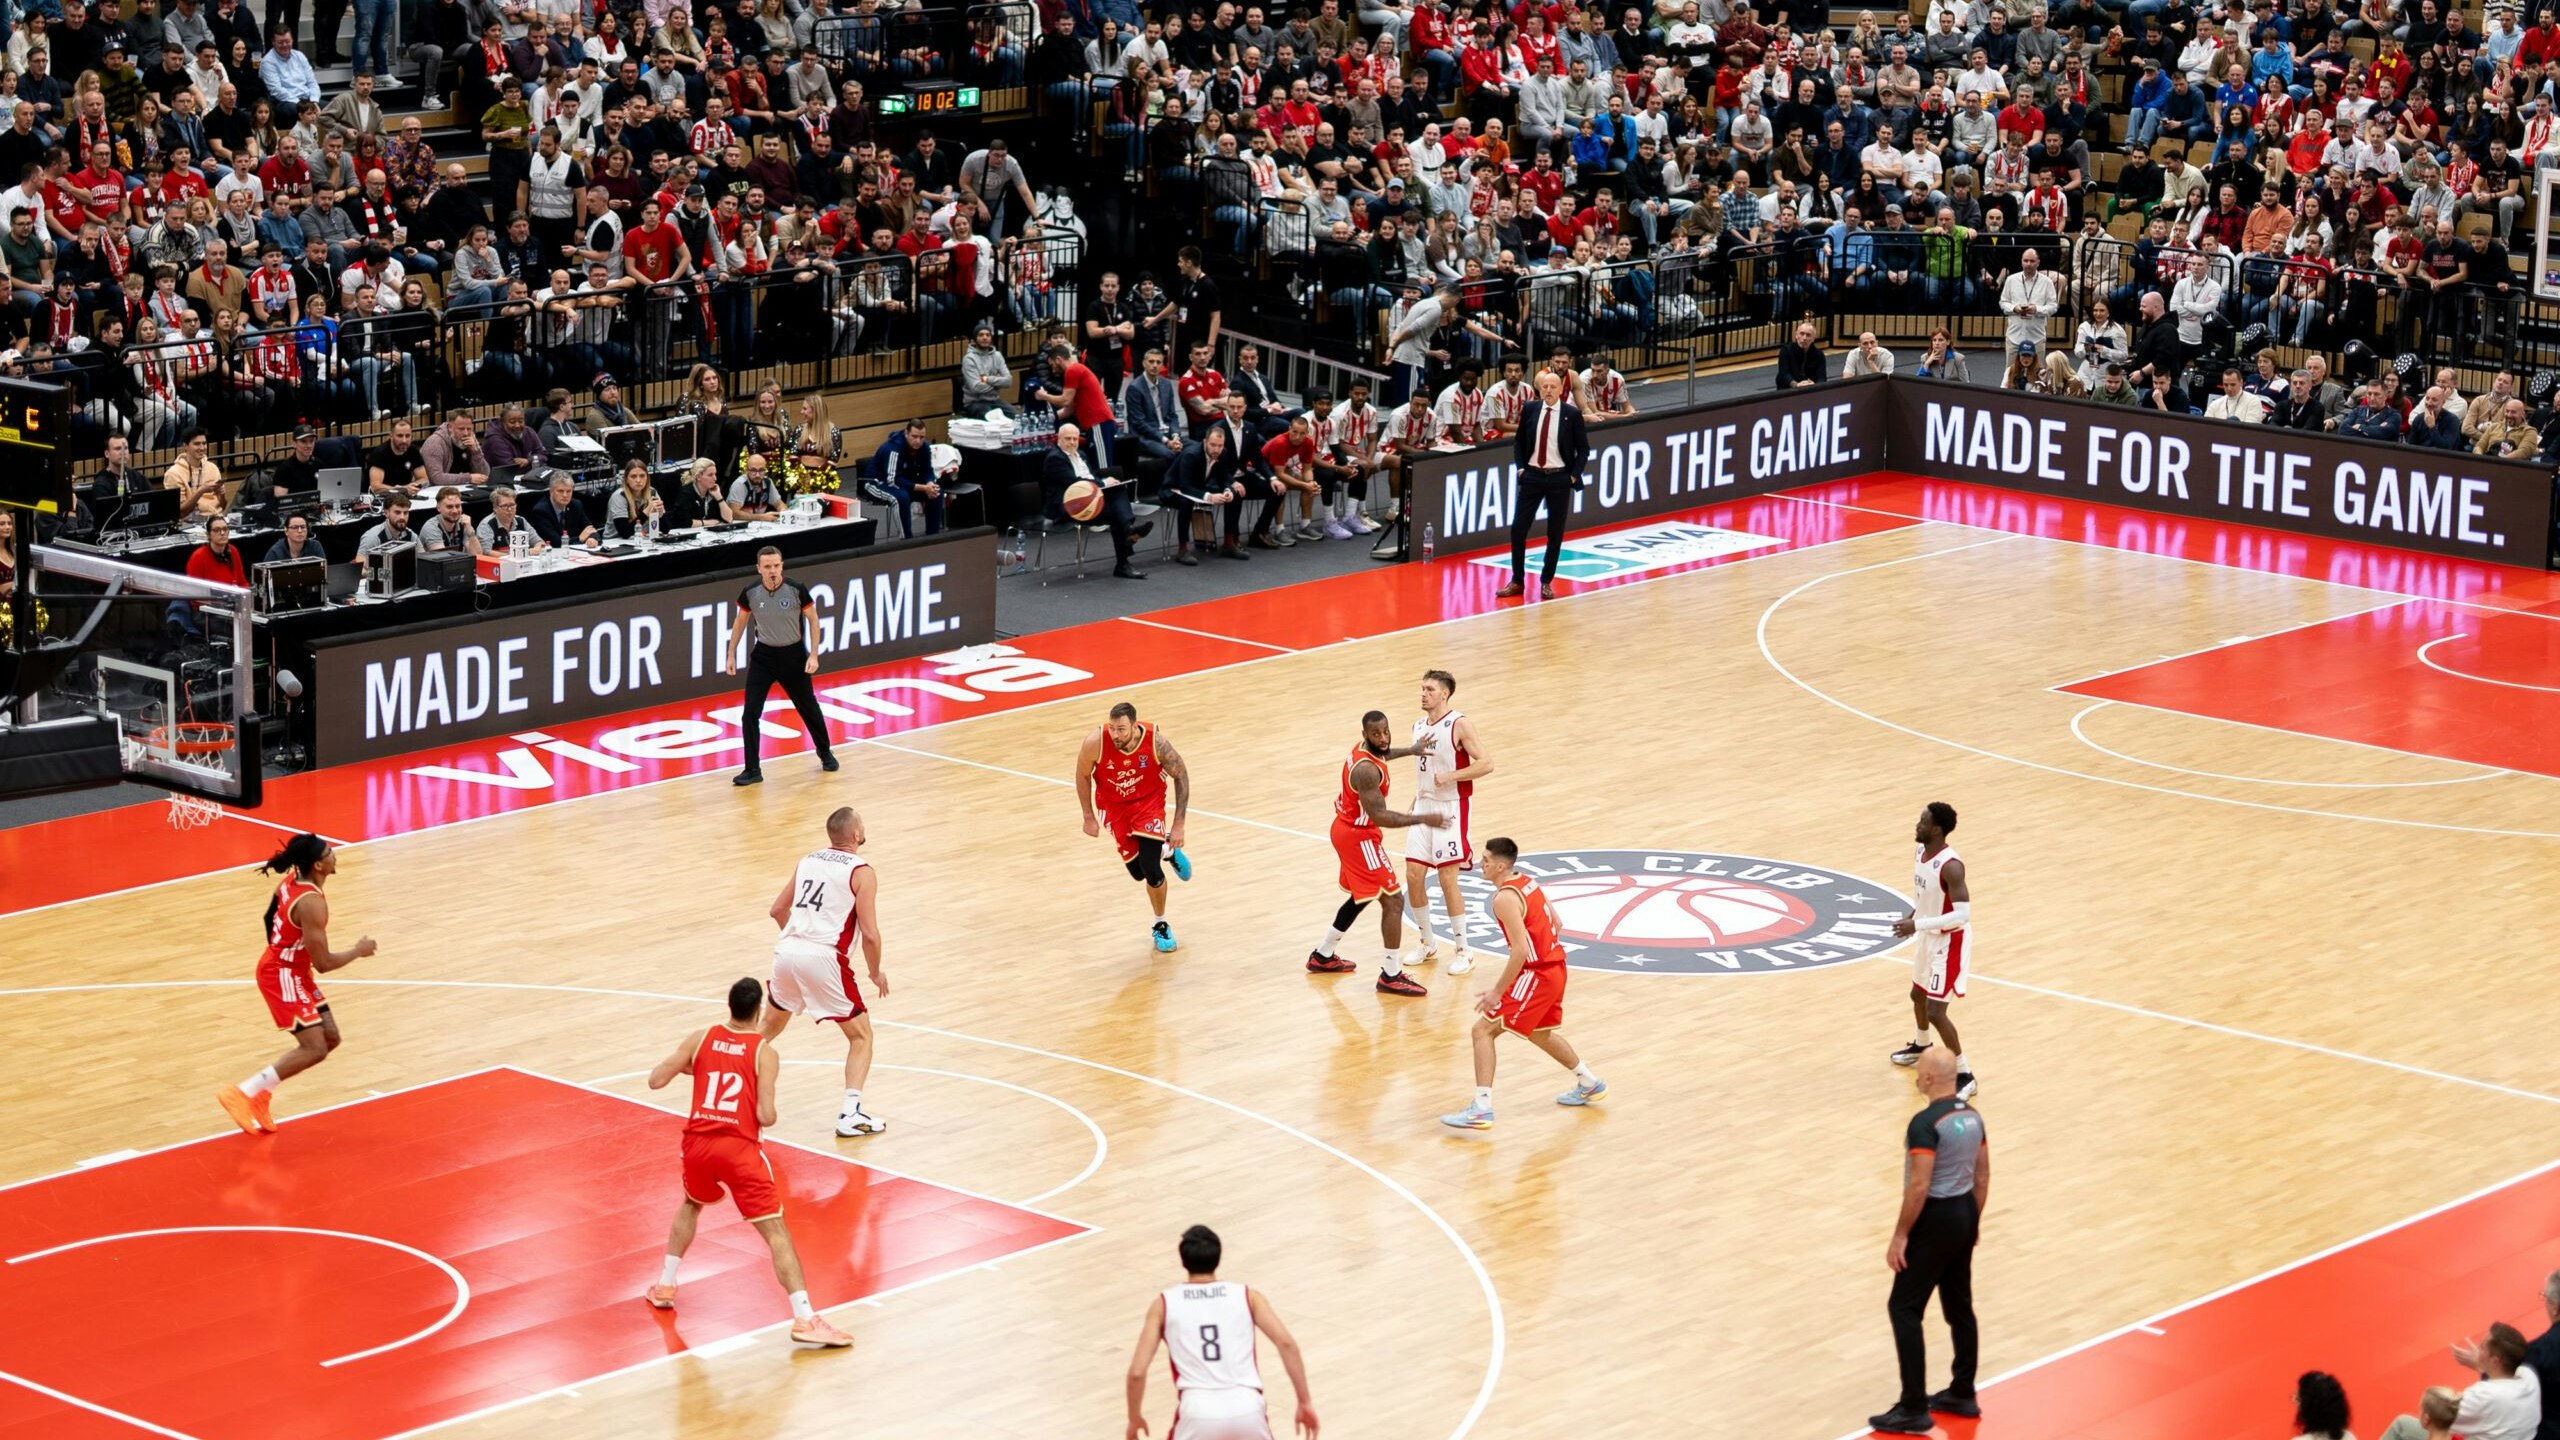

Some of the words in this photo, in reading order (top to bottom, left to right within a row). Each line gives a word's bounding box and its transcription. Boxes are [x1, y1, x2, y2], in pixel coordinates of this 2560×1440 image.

[917, 93, 932, 111] 18
[936, 92, 955, 110] 02
[1665, 424, 1736, 495] THE
[1750, 403, 1860, 479] GAME.
[1925, 402, 2066, 481] MADE
[2087, 426, 2190, 500] FOR
[2211, 443, 2311, 517] THE
[2333, 461, 2505, 546] GAME.
[1594, 527, 1727, 553] SAVA
[365, 639, 529, 739] MADE
[553, 615, 663, 704] FOR
[682, 602, 752, 678] TH
[804, 563, 961, 656] GAME.
[400, 656, 1095, 790] vienna
[1117, 768, 1137, 780] 20
[1448, 841, 1459, 857] 3
[1643, 855, 1834, 890] CLUB
[795, 879, 826, 912] 24
[1696, 911, 1903, 969] VIENNA
[701, 1070, 744, 1113] 12
[1199, 1324, 1222, 1362] 8
